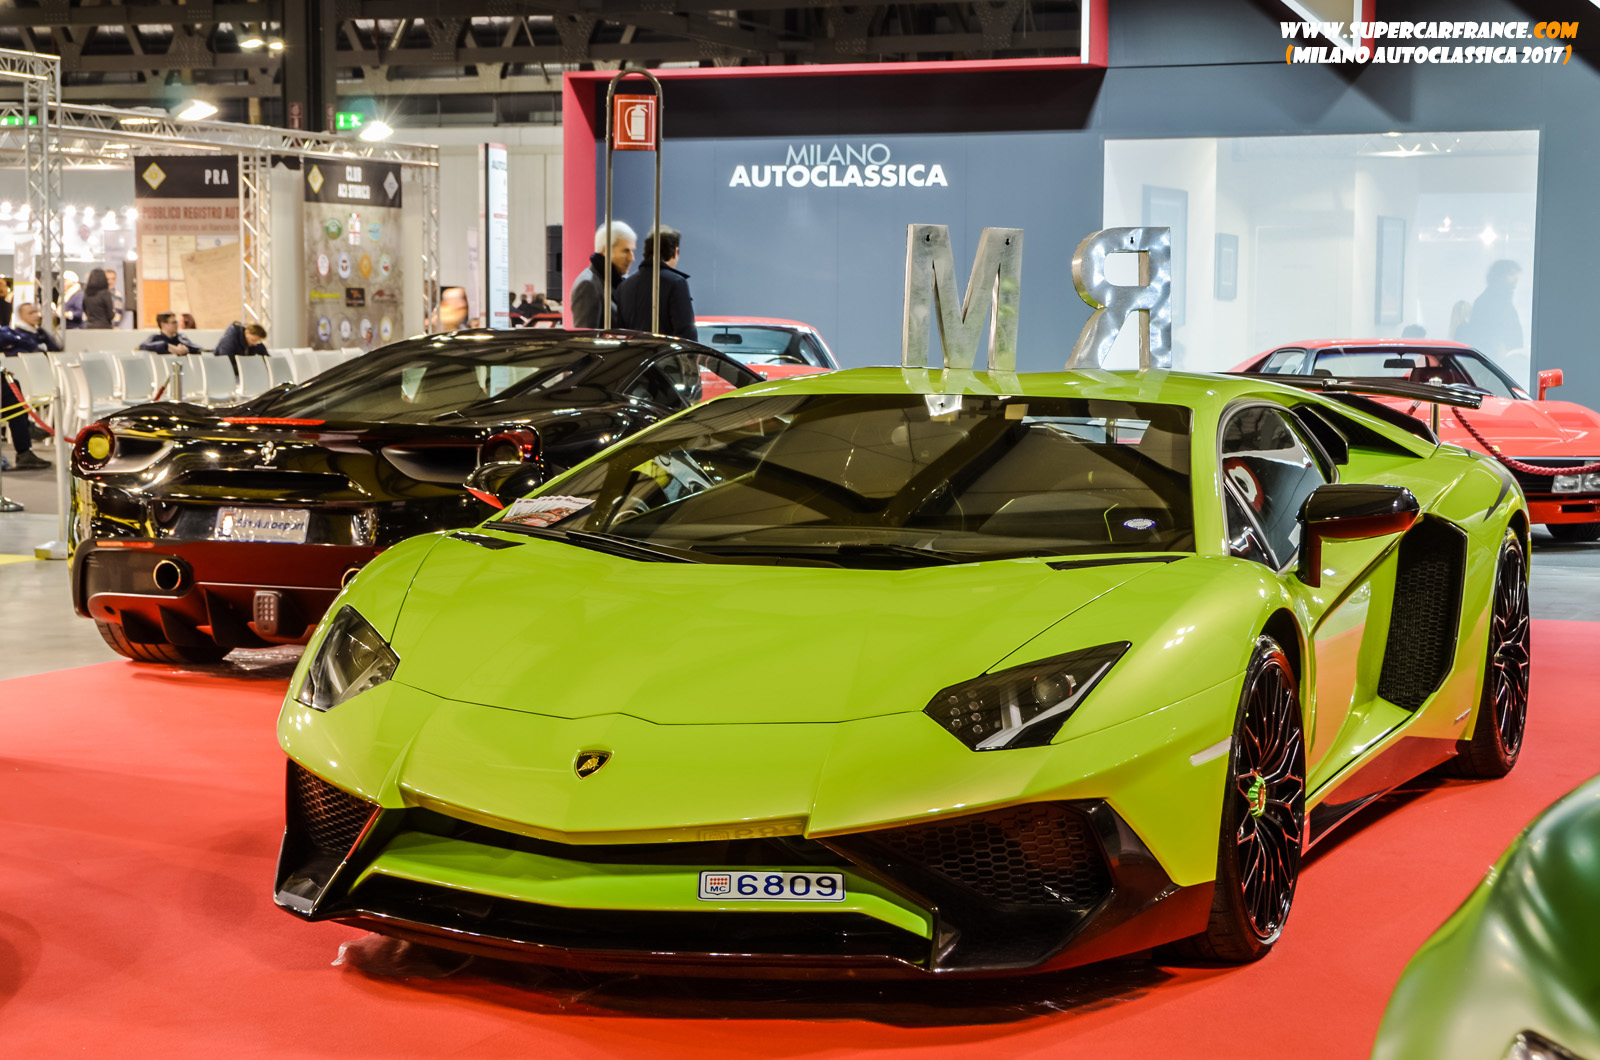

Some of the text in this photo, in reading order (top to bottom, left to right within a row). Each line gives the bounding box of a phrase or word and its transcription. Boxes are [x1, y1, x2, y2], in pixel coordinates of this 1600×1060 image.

[785, 143, 891, 165] MILANO
[204, 169, 229, 185] PRA
[729, 164, 948, 188] AUTOCLASSICA
[183, 206, 222, 219] REGISTRO
[709, 874, 837, 897] MC 6809
